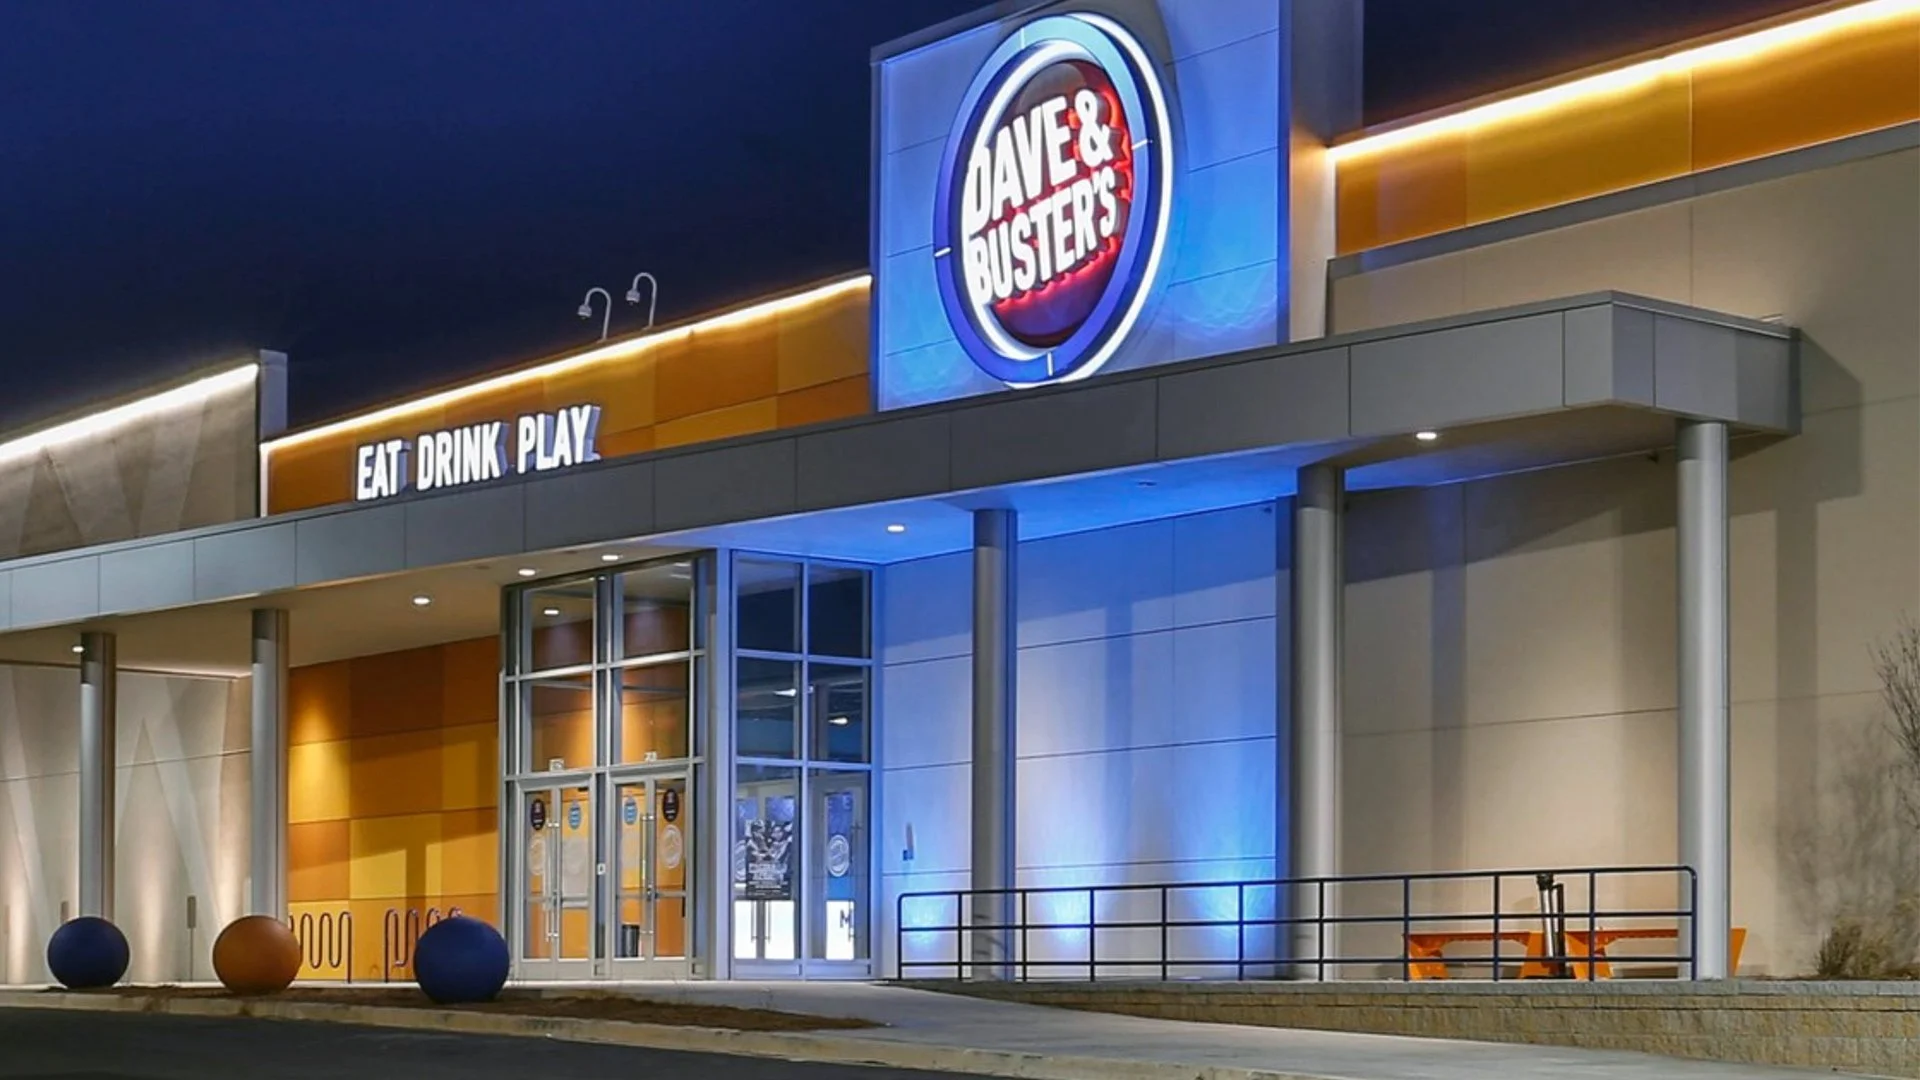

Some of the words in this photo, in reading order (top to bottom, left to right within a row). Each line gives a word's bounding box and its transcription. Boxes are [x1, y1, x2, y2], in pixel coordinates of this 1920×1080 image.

[963, 95, 1077, 236] DAVE
[1075, 89, 1114, 168] &
[963, 166, 1117, 306] BUSTER'S
[357, 439, 405, 501] EAT
[416, 421, 504, 492] DRINK
[517, 404, 594, 475] PLAY
